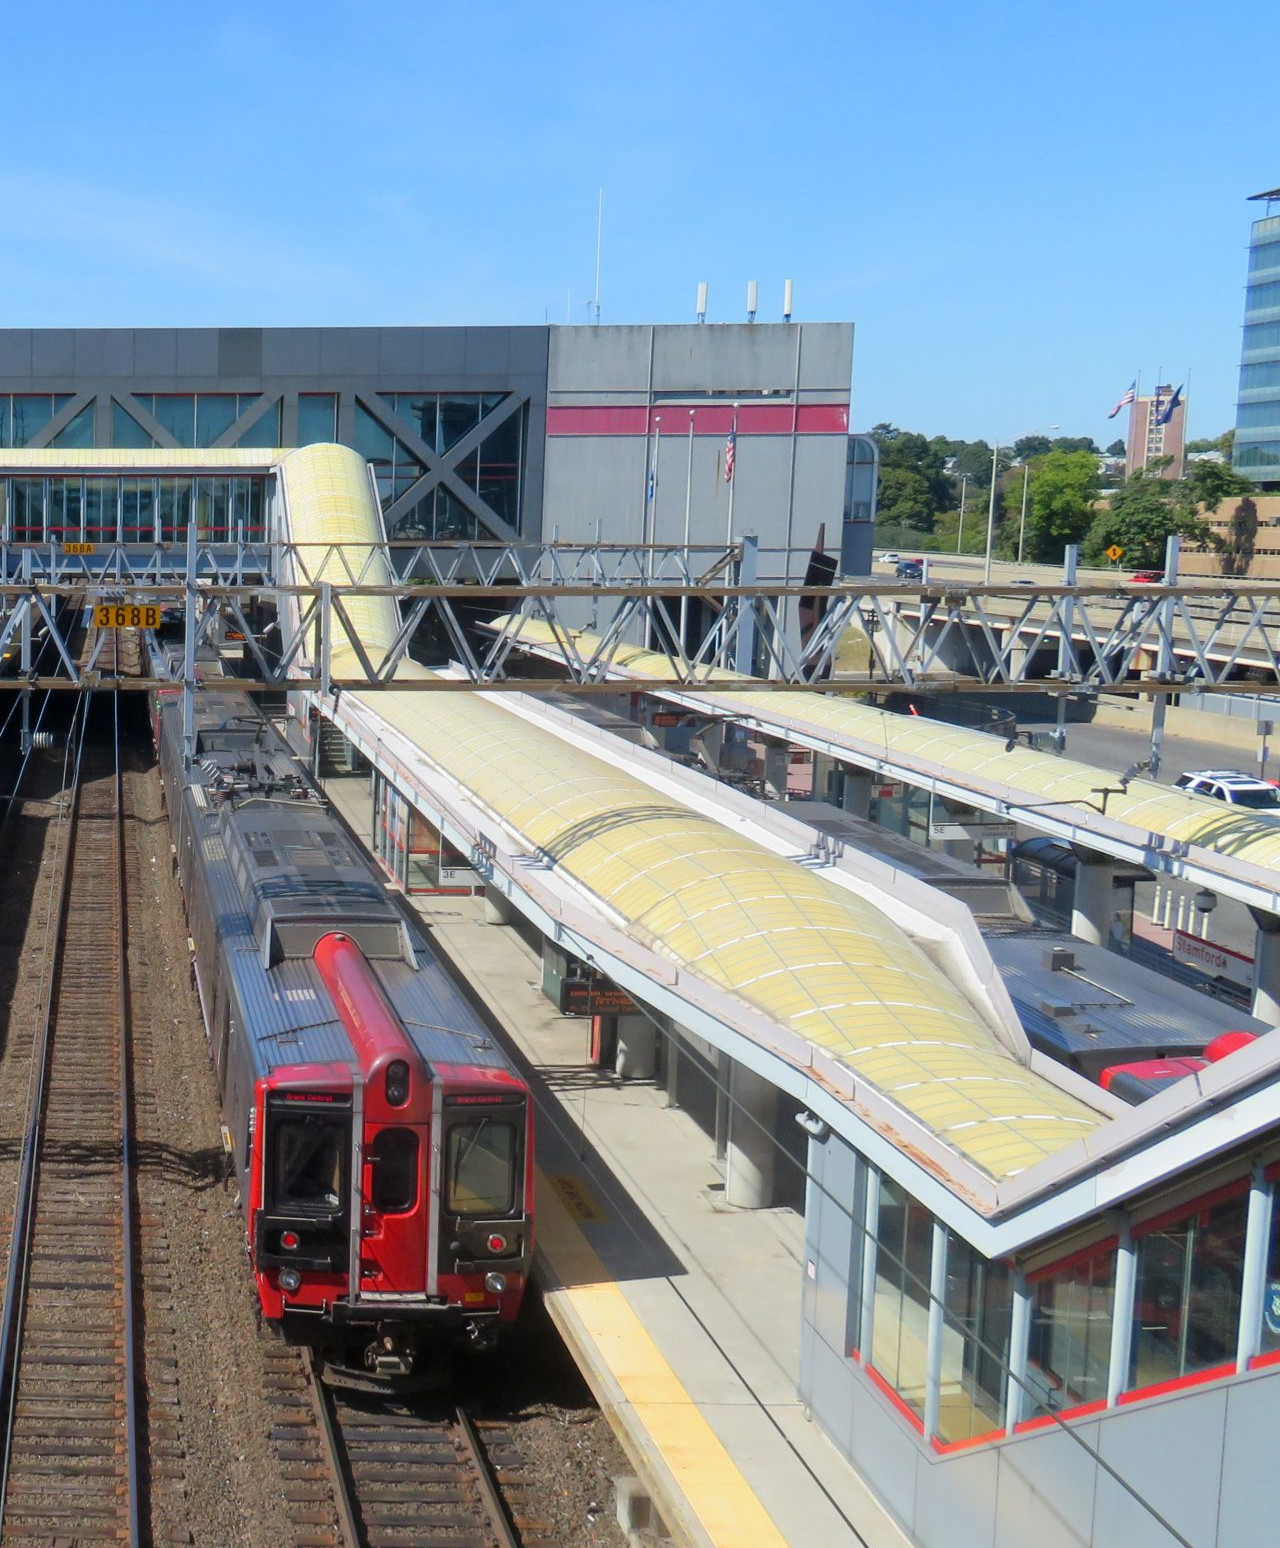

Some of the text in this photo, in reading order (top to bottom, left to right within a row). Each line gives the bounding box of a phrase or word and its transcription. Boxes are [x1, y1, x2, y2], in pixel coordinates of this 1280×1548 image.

[65, 544, 93, 554] 368A
[99, 607, 157, 626] 368B
[443, 870, 456, 879] 3E
[1176, 935, 1222, 967] Stamford
